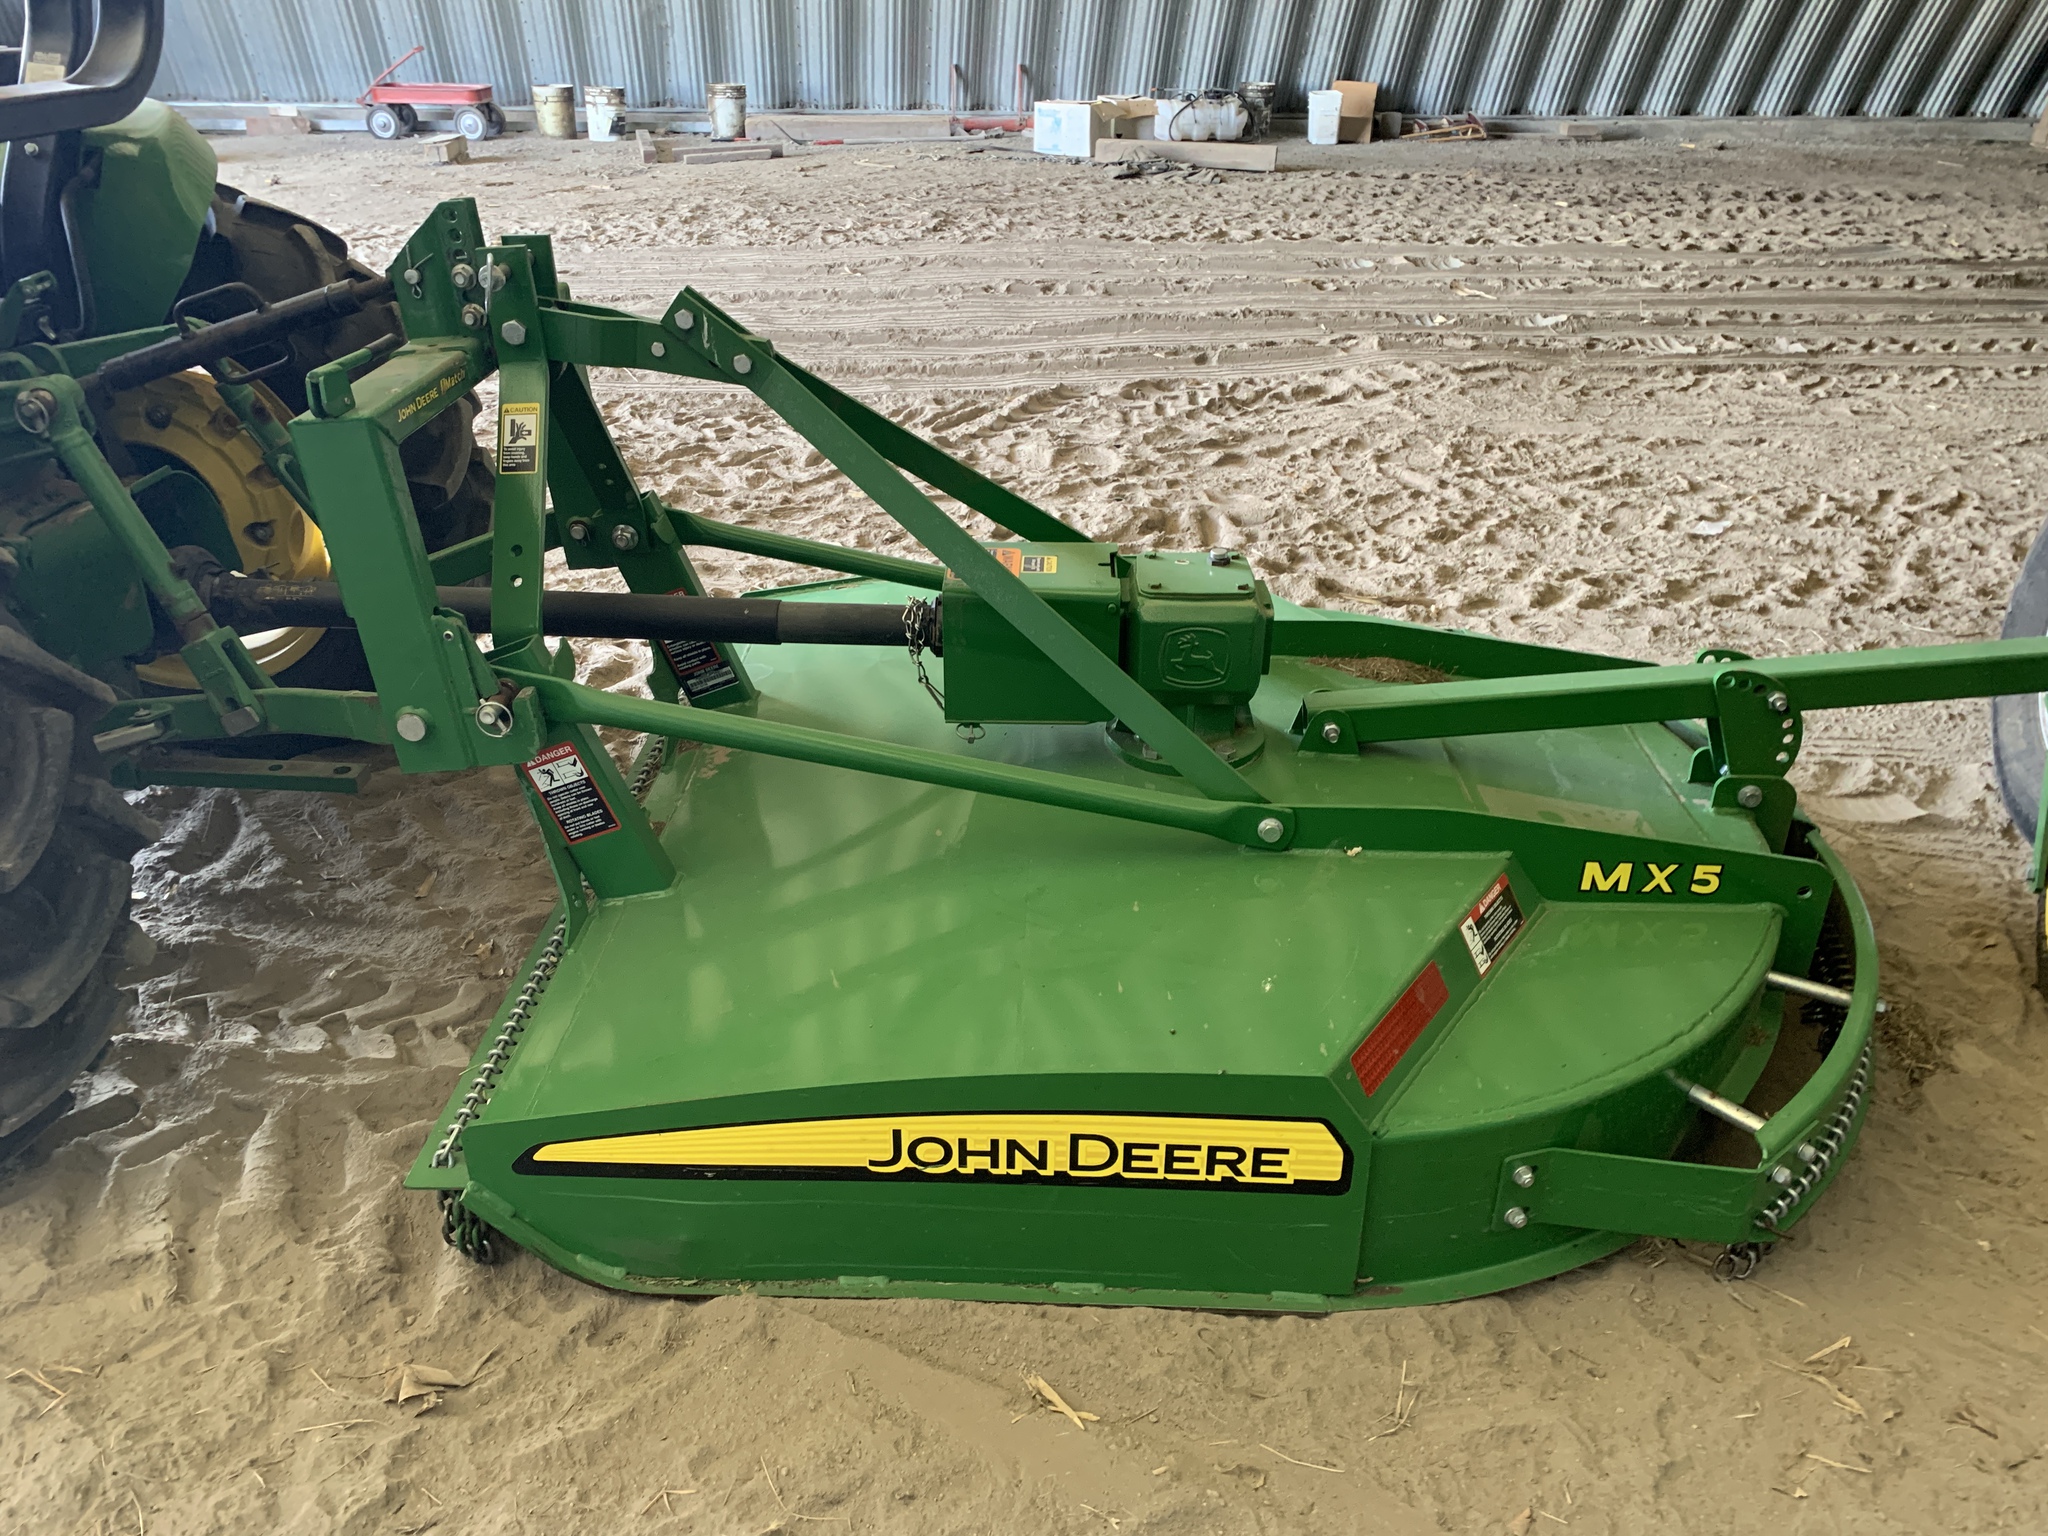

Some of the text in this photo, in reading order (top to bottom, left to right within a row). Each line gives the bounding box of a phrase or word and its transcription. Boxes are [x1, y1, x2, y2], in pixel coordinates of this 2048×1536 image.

[398, 403, 416, 422] JOHN
[416, 387, 439, 409] DEERE
[535, 745, 572, 764] DANGER
[566, 809, 603, 824] ROTATING BLADES
[1483, 883, 1501, 906] DANGER
[868, 1128, 1293, 1182] JOHN DEERE
